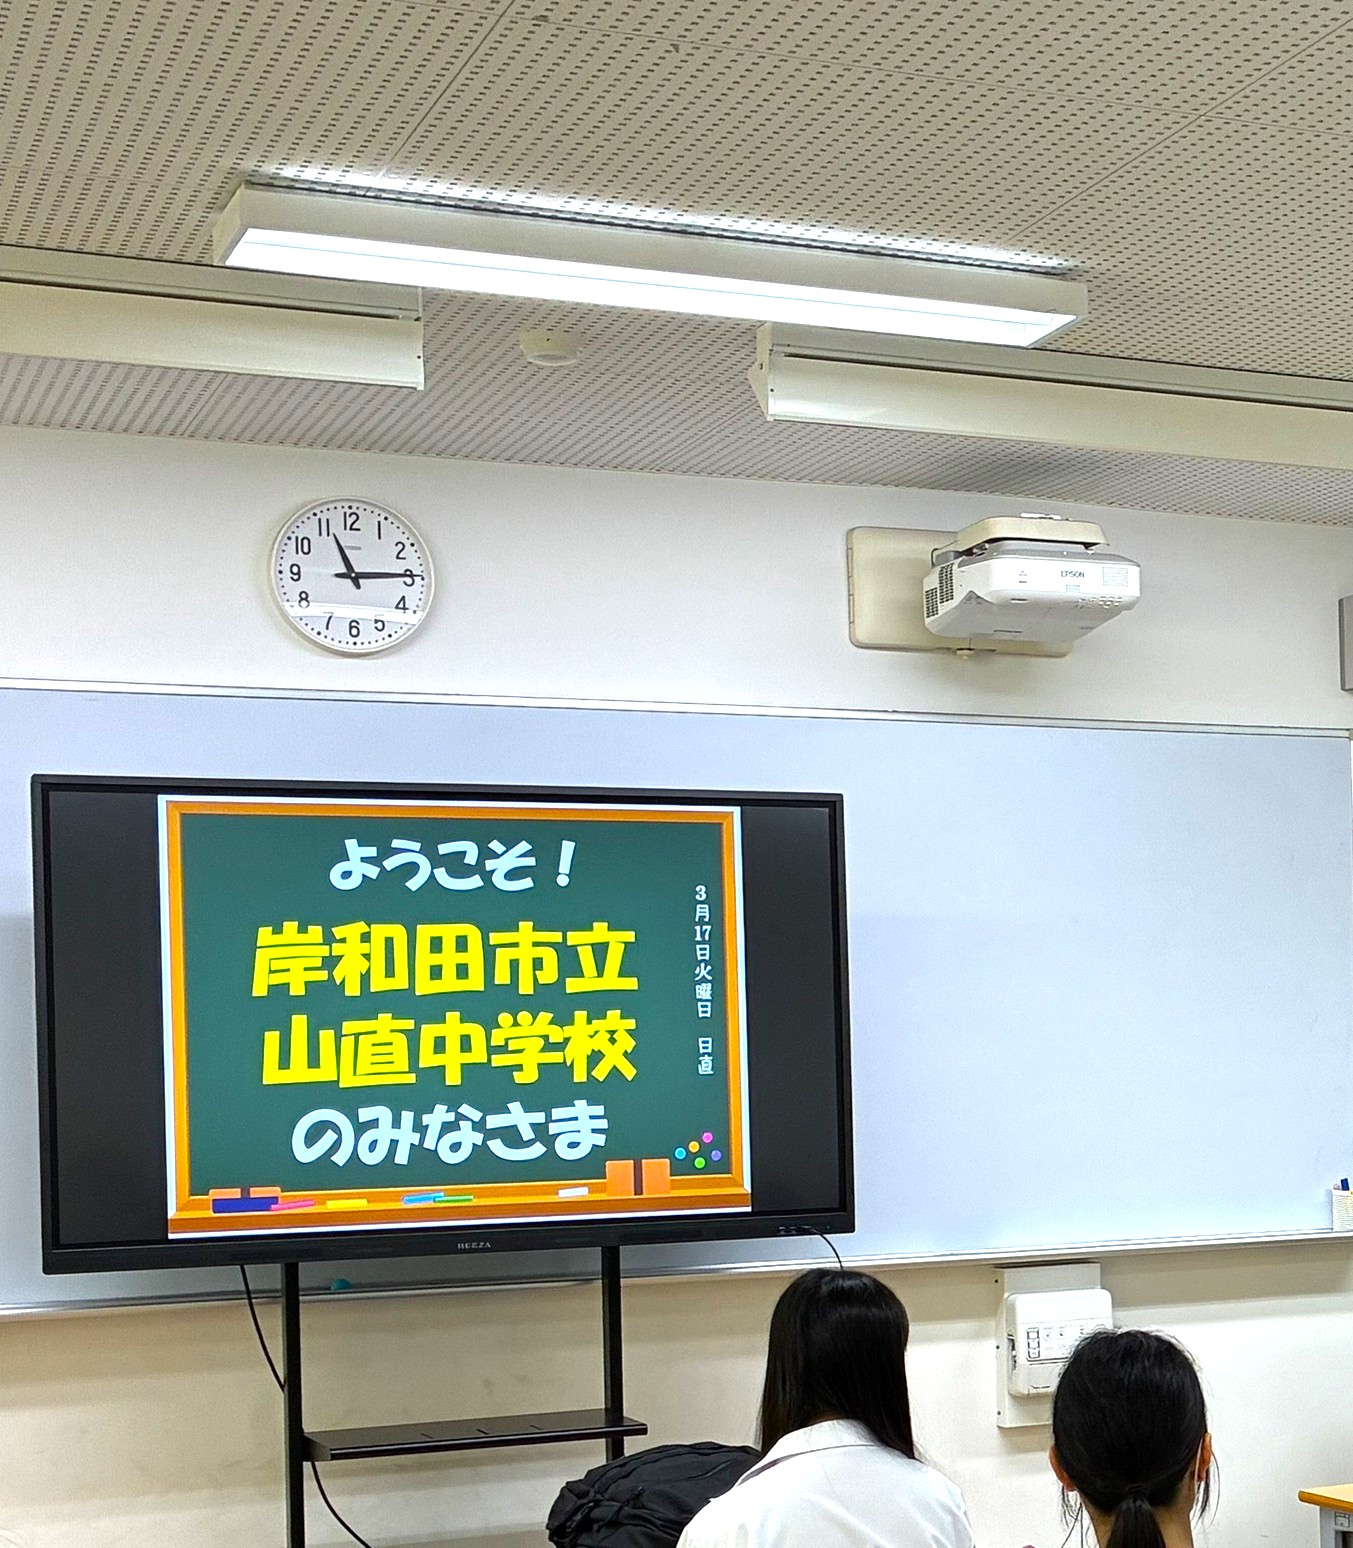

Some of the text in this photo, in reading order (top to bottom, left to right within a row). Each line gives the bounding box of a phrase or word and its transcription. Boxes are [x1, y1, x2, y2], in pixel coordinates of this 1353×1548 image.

[318, 517, 330, 537] 11
[343, 511, 361, 531] 12
[377, 520, 381, 540] 1
[294, 535, 311, 555] 10
[394, 541, 407, 560] 2
[289, 563, 301, 582] 9
[402, 568, 415, 587] 3
[298, 590, 310, 609] 8
[394, 595, 409, 613] 4
[323, 611, 334, 630] 7
[349, 620, 360, 638] 6
[373, 614, 385, 632] 5
[252, 921, 639, 997] 岸和田市立
[694, 885, 714, 1075] 3月17日火曜日 日直
[262, 1009, 638, 1088] 山直中学校
[291, 1099, 609, 1167] のみなさま
